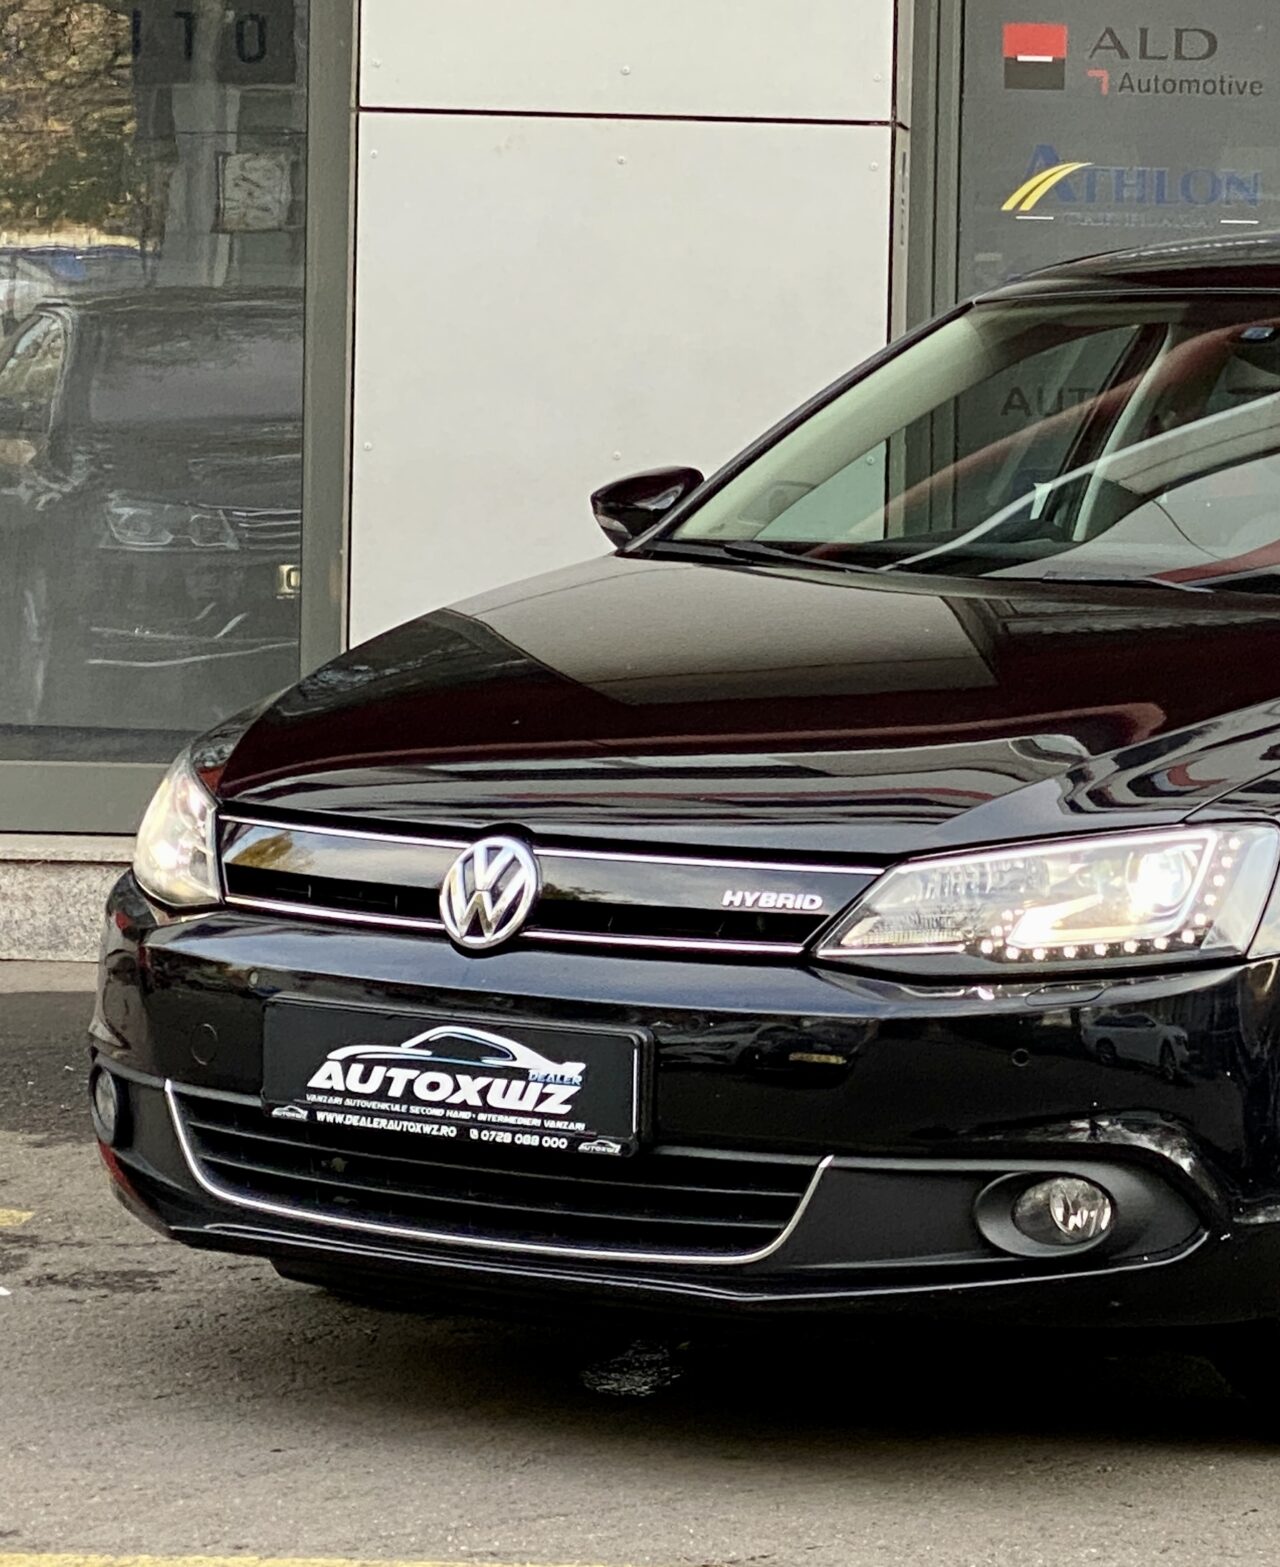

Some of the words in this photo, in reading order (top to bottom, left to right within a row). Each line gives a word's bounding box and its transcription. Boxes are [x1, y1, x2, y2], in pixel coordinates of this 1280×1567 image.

[1089, 26, 1218, 61] ALD
[1118, 71, 1264, 96] Automotive
[1018, 143, 1263, 208] ATHLON
[722, 889, 823, 910] HYBRID
[307, 1060, 581, 1115] AUTOXWZ
[528, 1069, 583, 1086] DEALER
[316, 1111, 457, 1138] WWW.DEALERAUTOXWZ.RO
[409, 1105, 445, 1117] SECOND
[446, 1110, 472, 1120] HAND
[542, 1136, 568, 1150] 000
